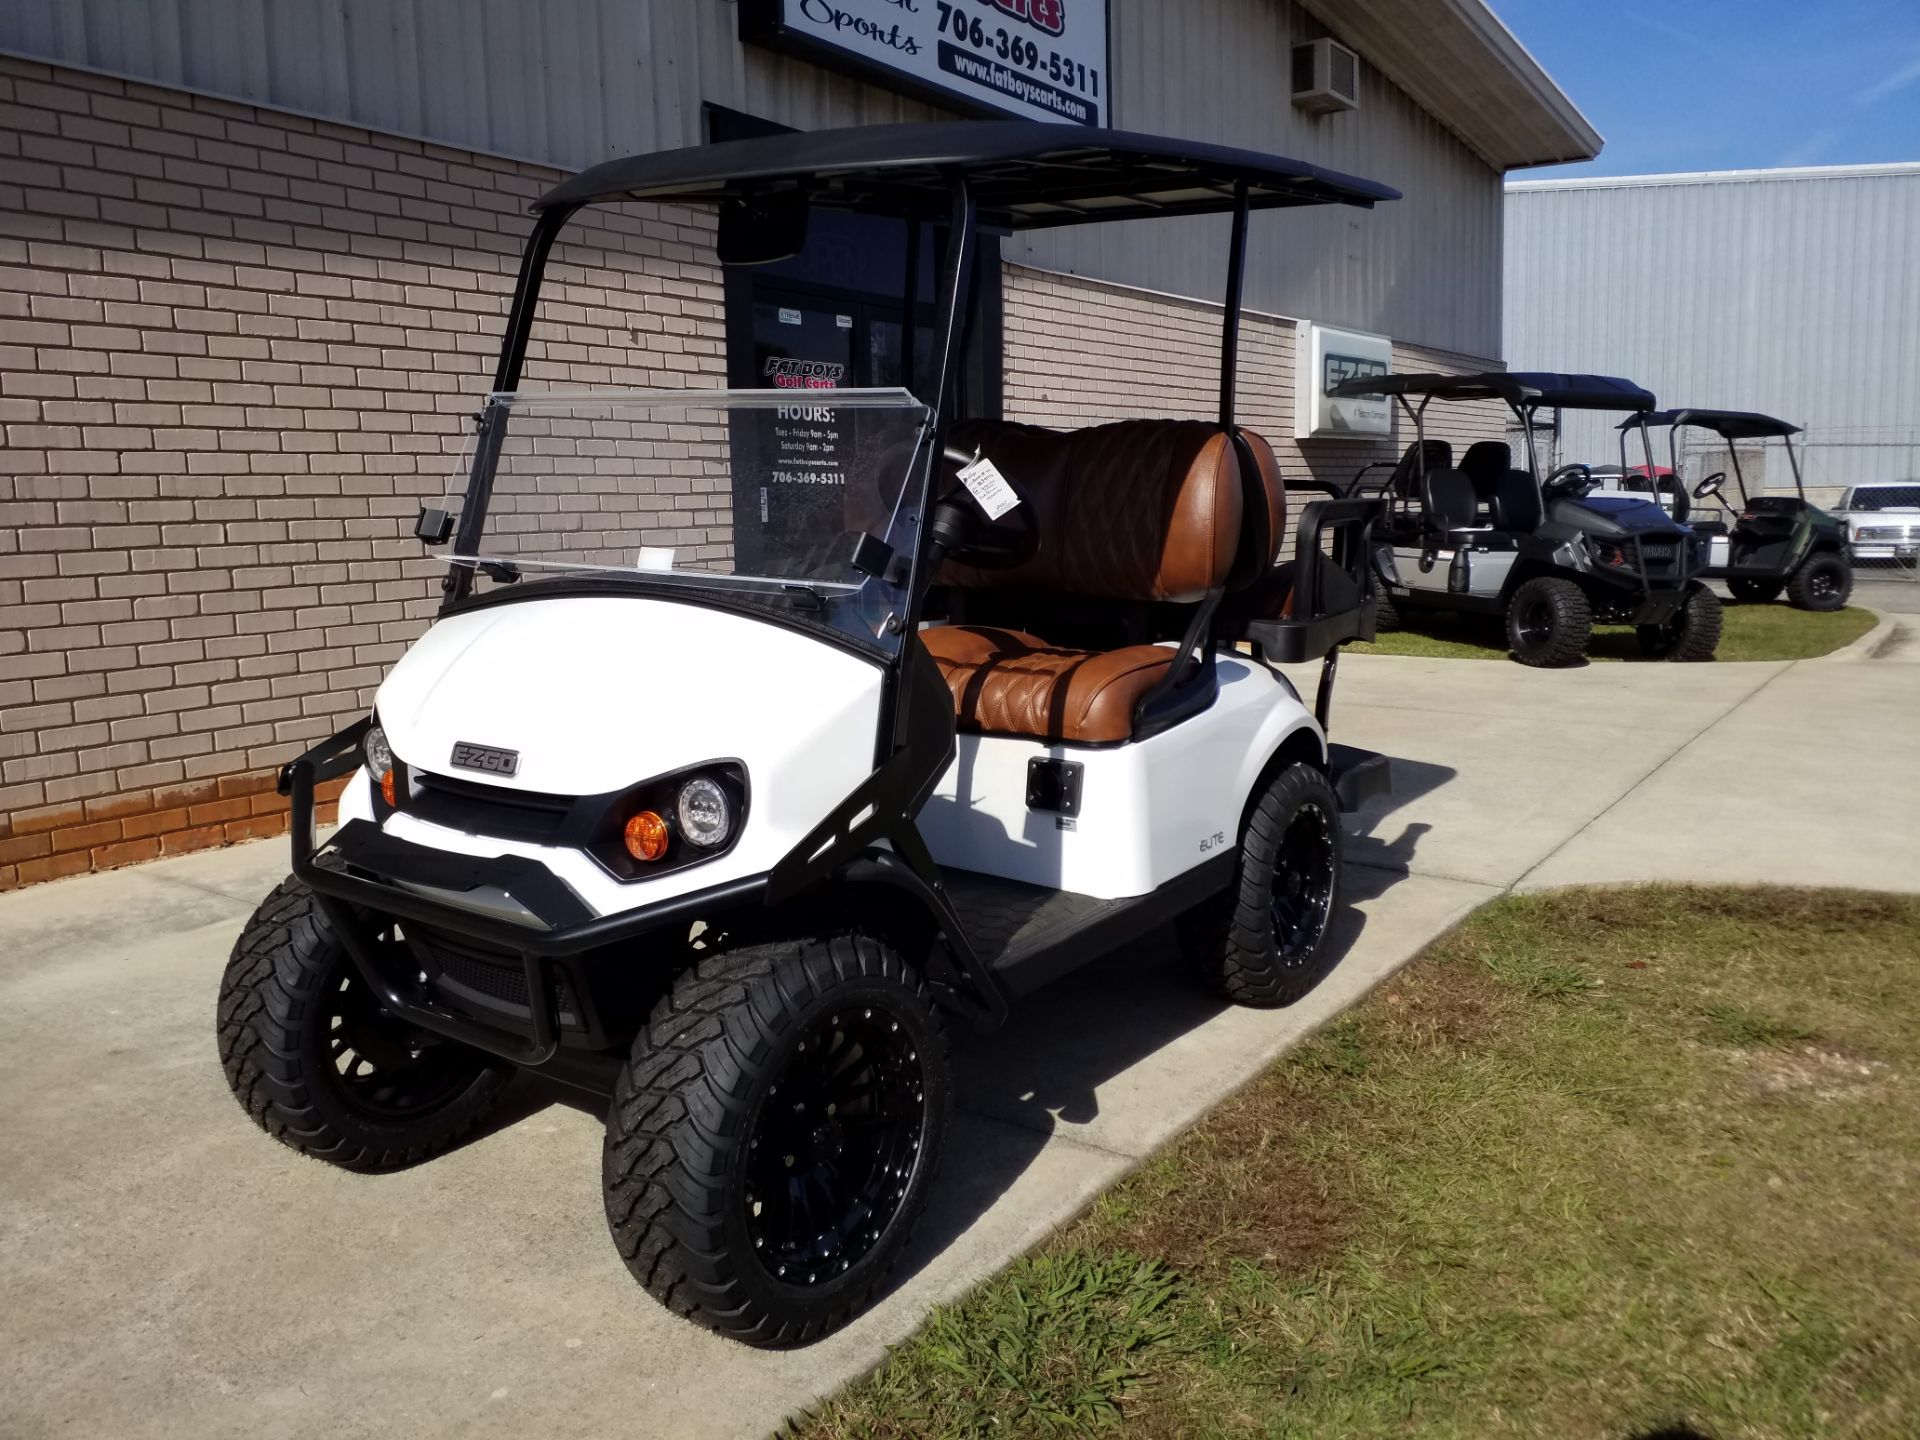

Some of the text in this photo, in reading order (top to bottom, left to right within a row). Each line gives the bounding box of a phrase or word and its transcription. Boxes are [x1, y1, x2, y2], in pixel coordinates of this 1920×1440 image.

[937, 0, 1098, 98] 706-369-5311
[954, 54, 1087, 120] www.fatboyscarts.com
[765, 357, 843, 380] FAT BOYS
[774, 374, 835, 389] Golf Carts
[777, 405, 835, 423] HOURS:
[775, 427, 788, 437] Tues
[792, 428, 810, 439] Friday
[810, 429, 822, 439] 9am
[827, 429, 839, 441] 5pm
[781, 441, 806, 452] Saturday
[806, 442, 818, 451] 9am
[822, 442, 835, 453] 2pm
[772, 471, 845, 485] 706-369-5311
[452, 745, 518, 774] EZGO
[1200, 831, 1225, 853] ELITE
